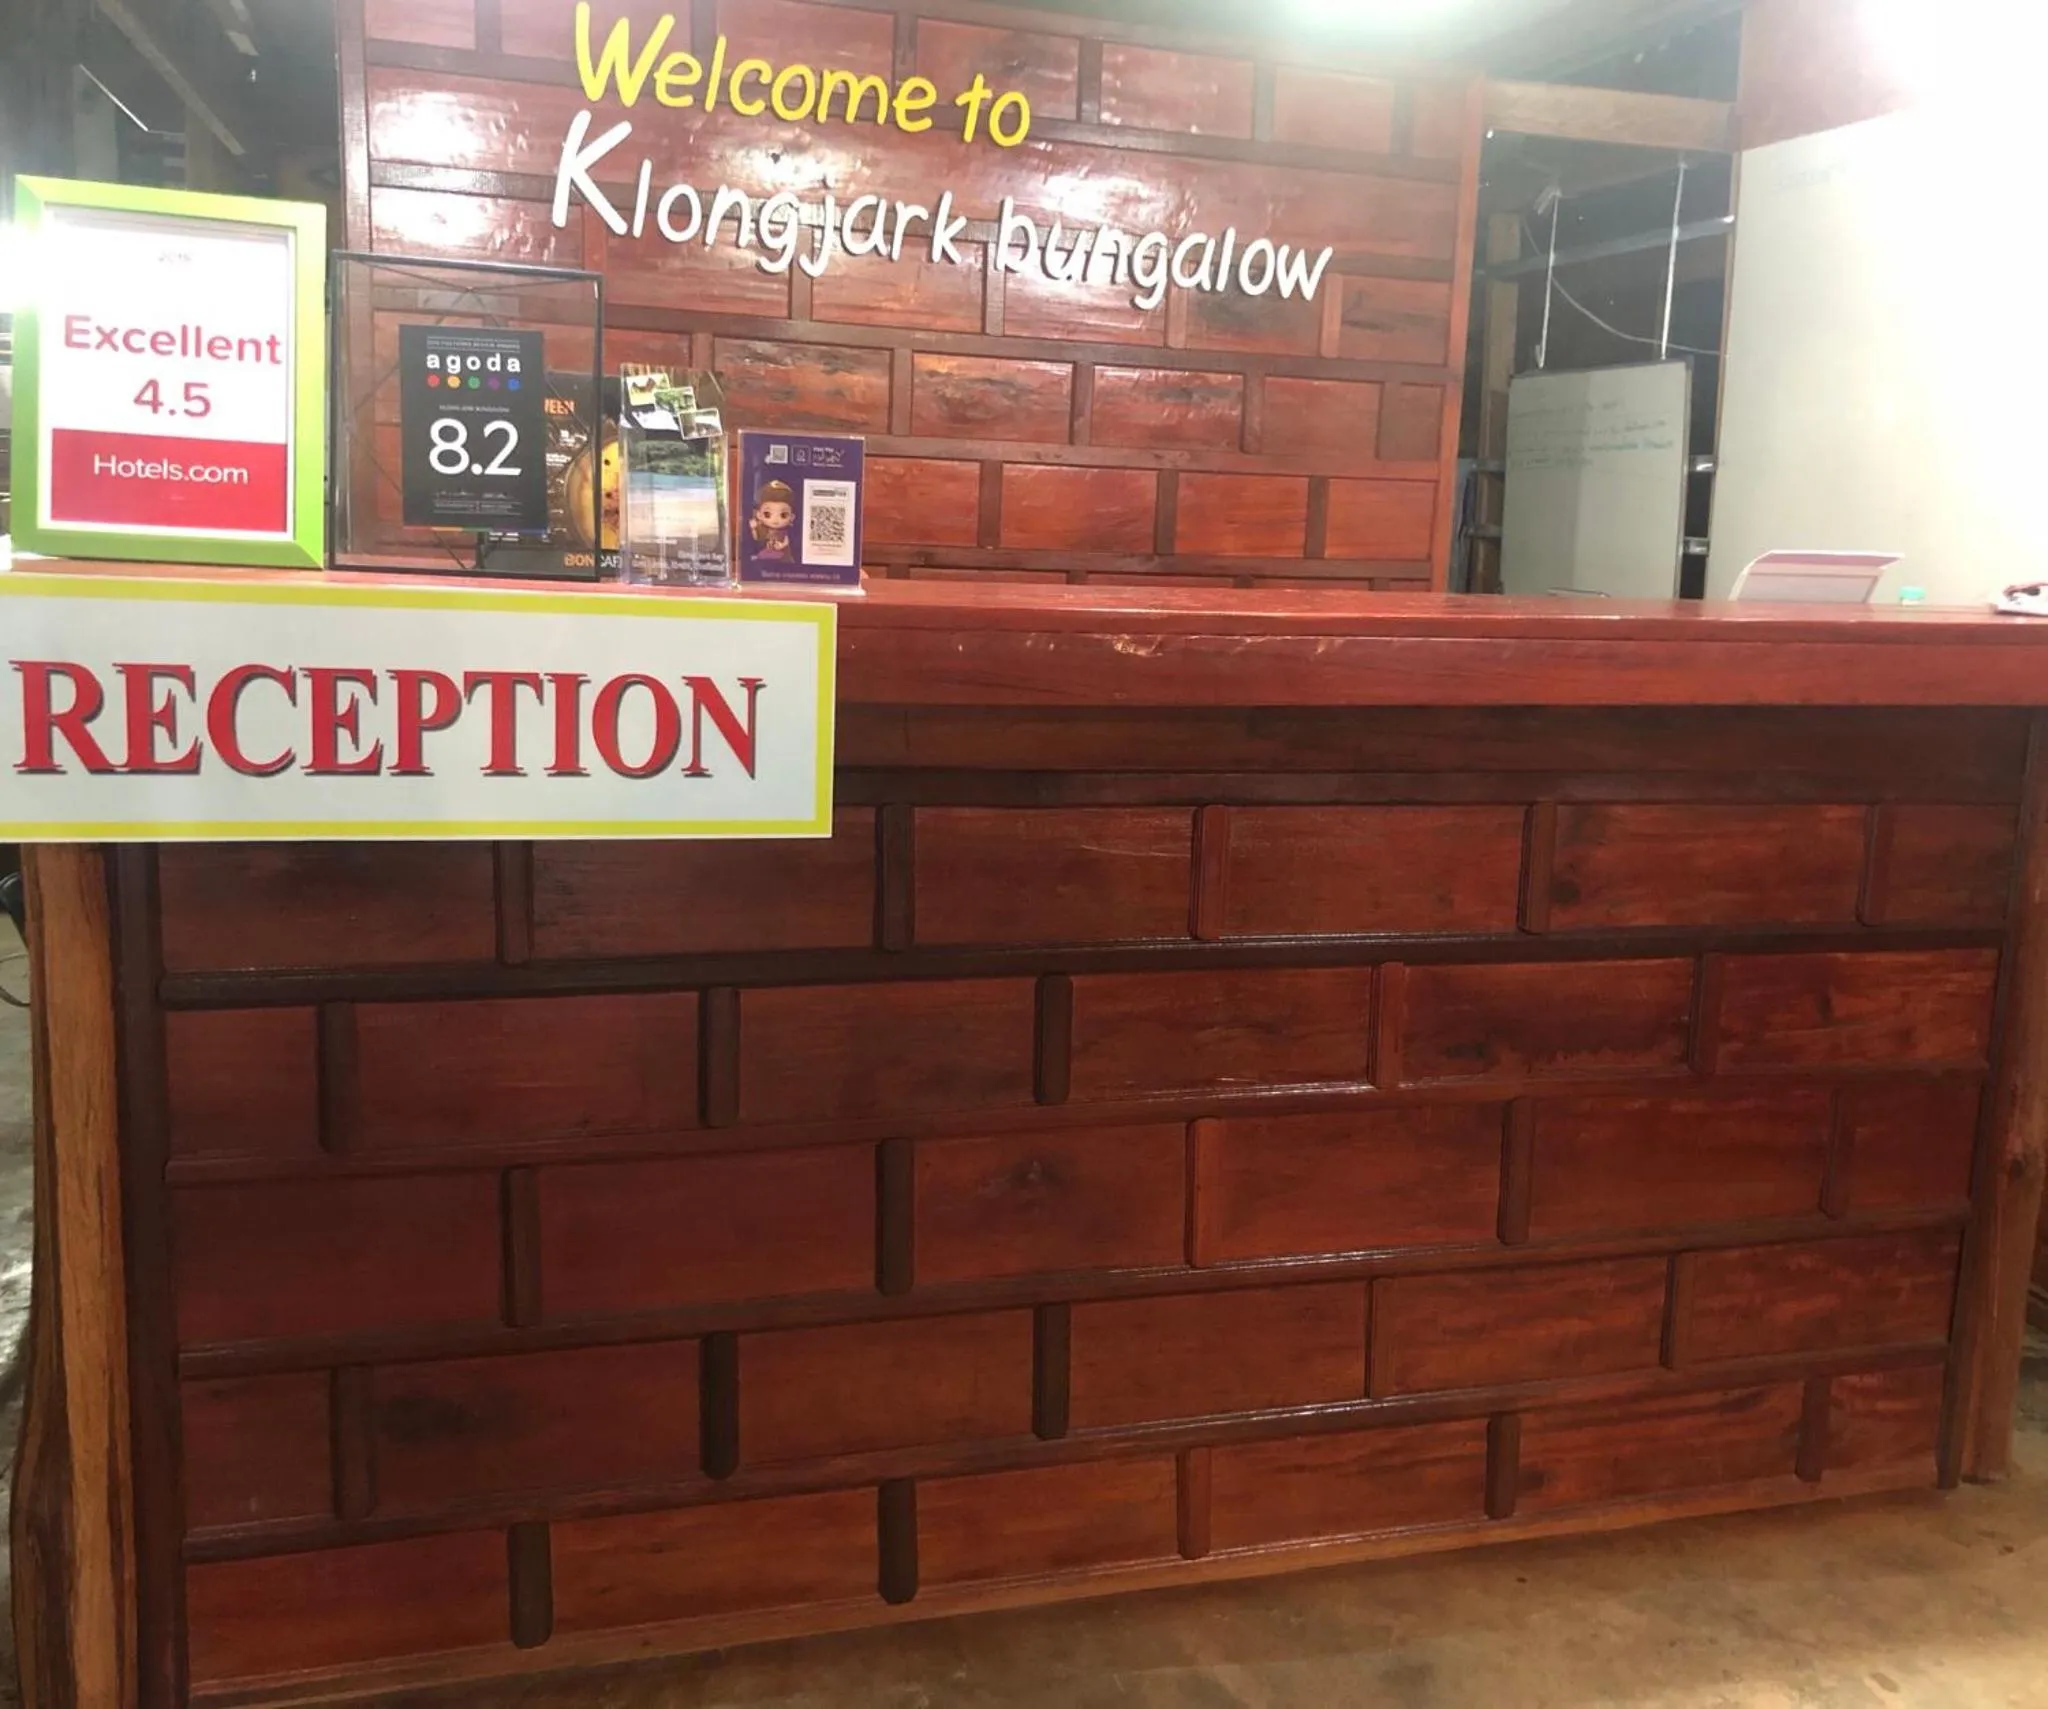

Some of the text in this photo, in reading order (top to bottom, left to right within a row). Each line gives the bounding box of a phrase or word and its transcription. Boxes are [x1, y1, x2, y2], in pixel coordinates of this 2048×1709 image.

[574, 1, 1032, 147] Welcome to
[991, 195, 1335, 309] bungalow
[63, 314, 282, 364] Excellent
[426, 352, 521, 375] agoda
[133, 379, 212, 418] 4.5
[93, 454, 249, 485] Hotels.com
[429, 417, 522, 476] 8.2
[9, 659, 767, 779] RECEPTION
